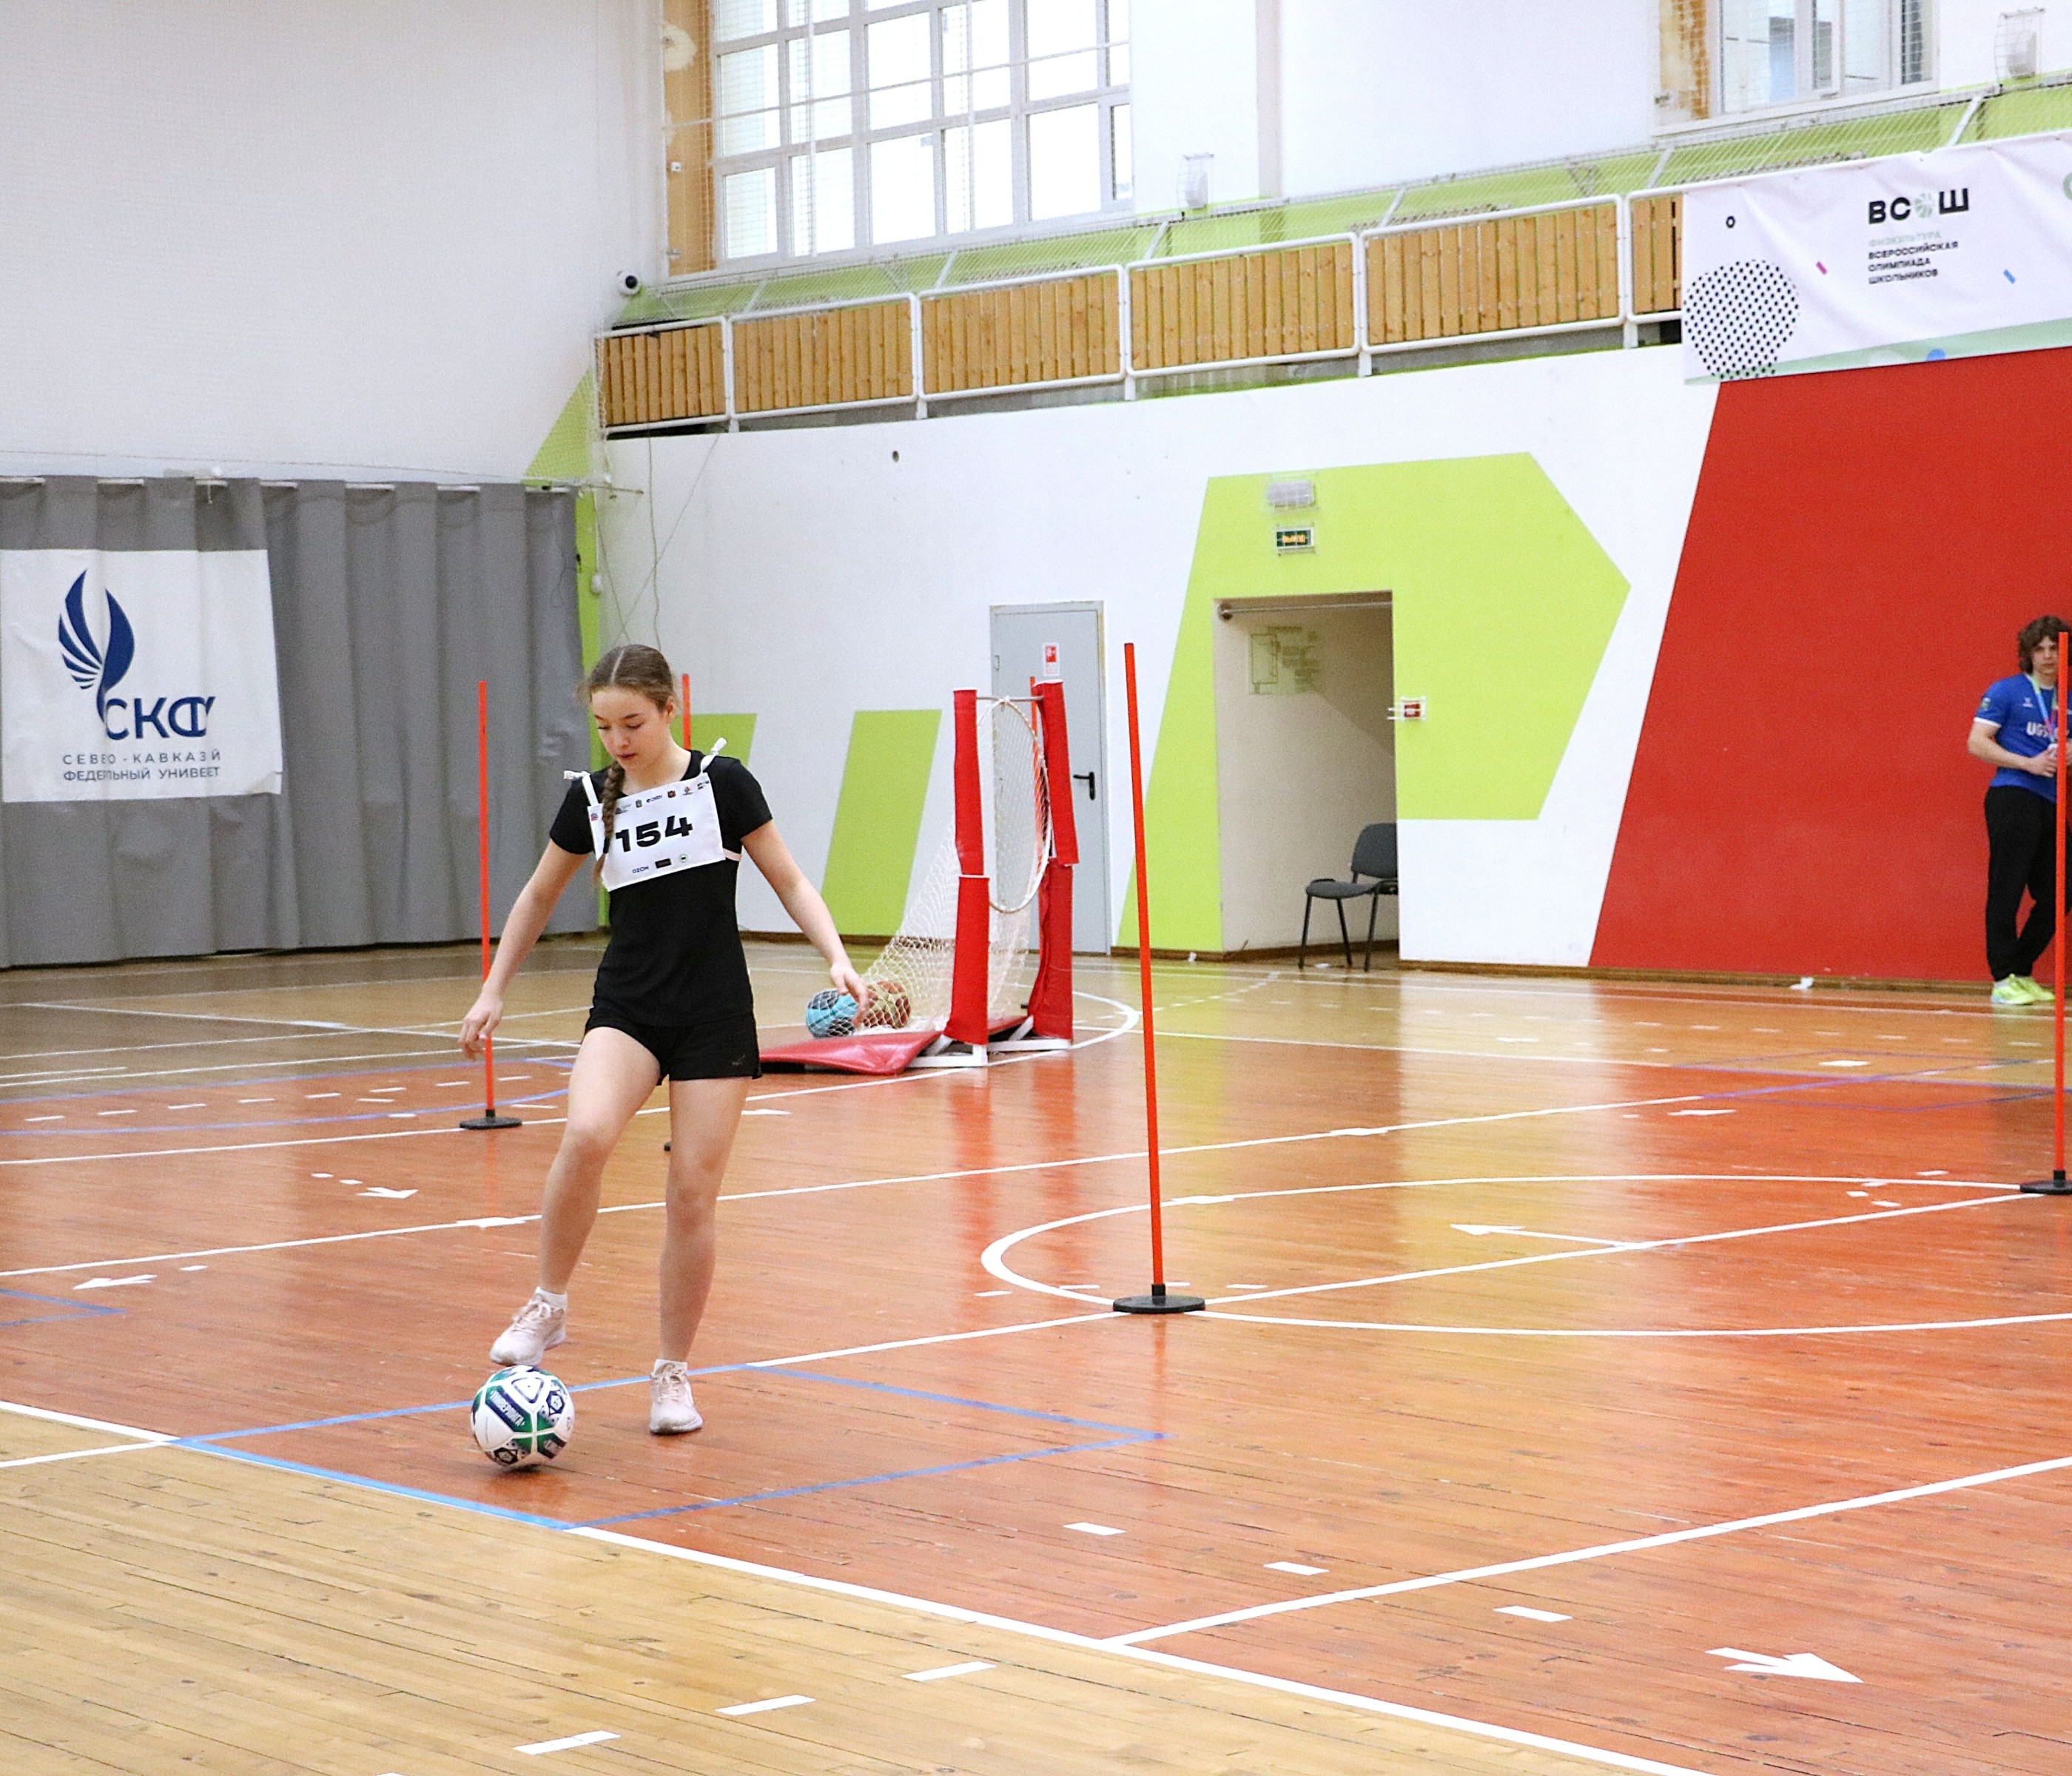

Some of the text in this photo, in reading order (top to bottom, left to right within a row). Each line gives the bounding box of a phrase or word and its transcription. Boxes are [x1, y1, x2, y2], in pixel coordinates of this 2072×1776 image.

[1868, 241, 1959, 259] ВСЕРОССИЙСКАЯ
[1868, 258, 1931, 272] ОЛИМПИАДА
[1868, 269, 1939, 284] ШКОЛЬНИКОВ
[616, 815, 693, 852] 154
[632, 866, 649, 874] OZON
